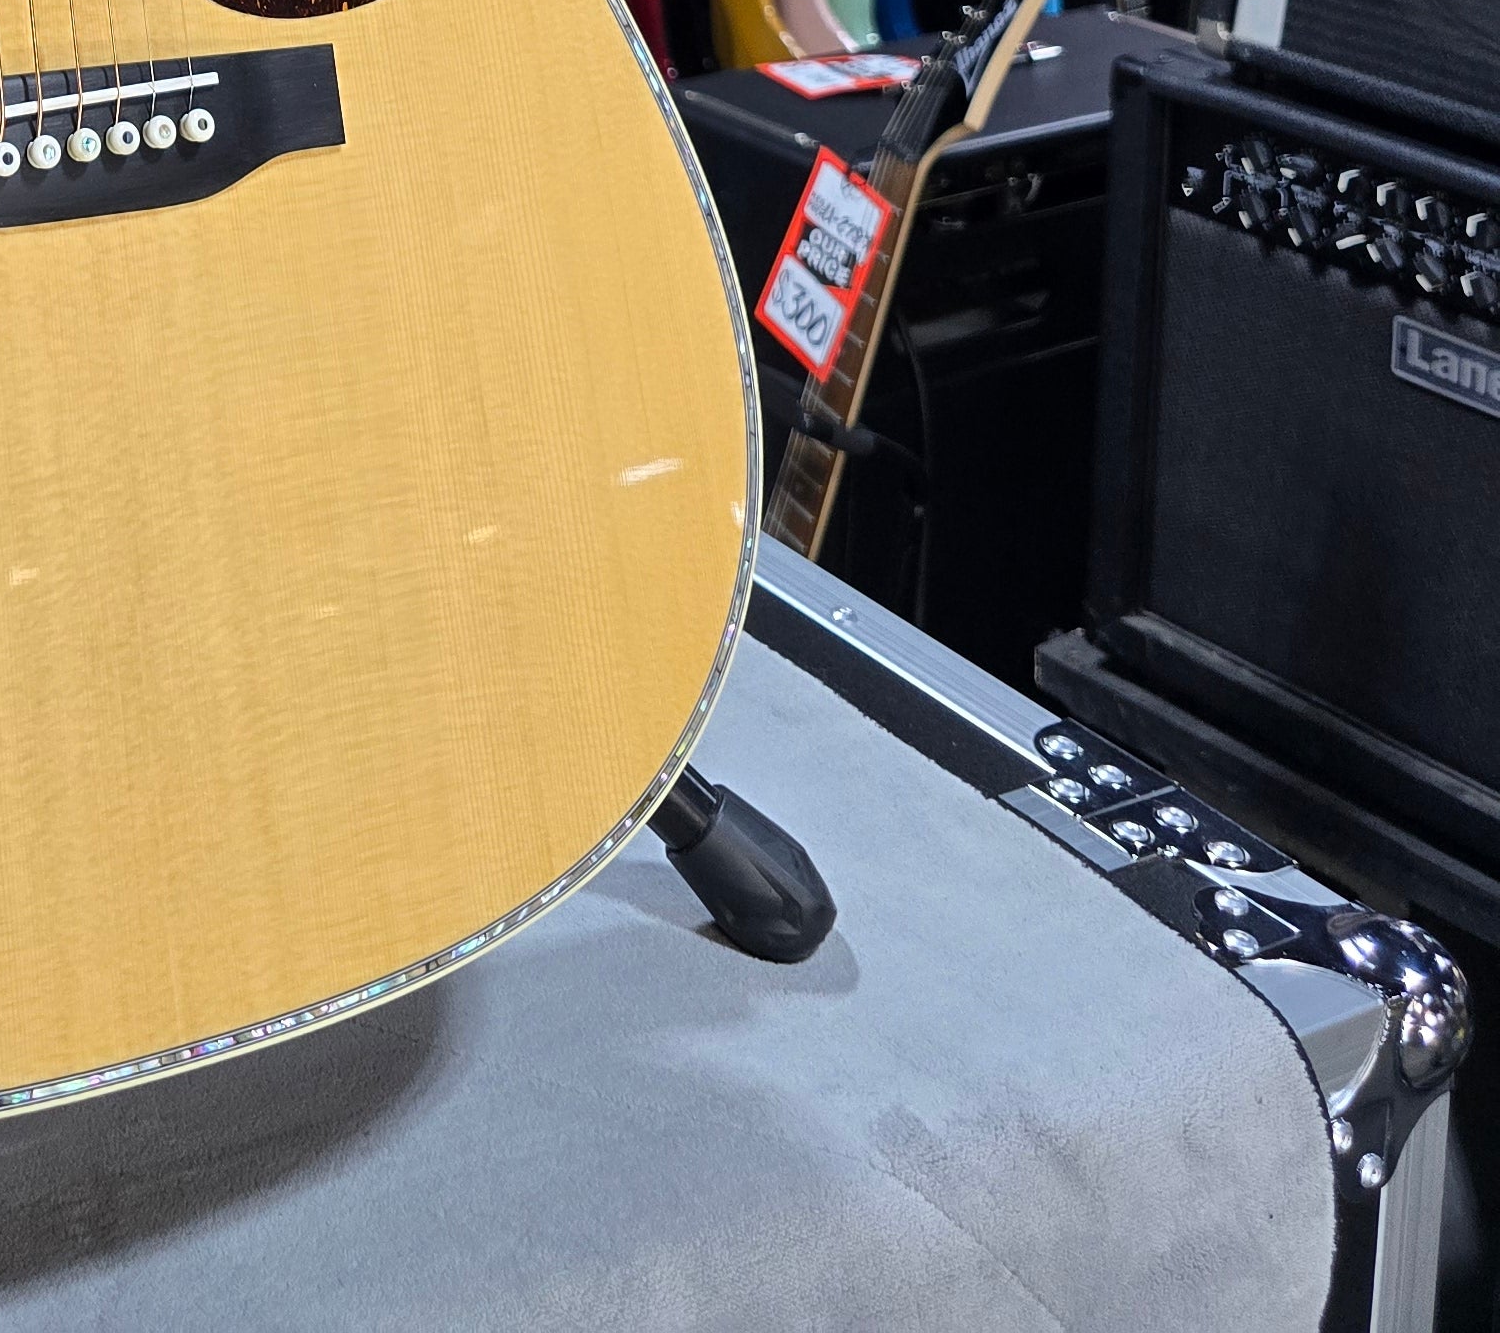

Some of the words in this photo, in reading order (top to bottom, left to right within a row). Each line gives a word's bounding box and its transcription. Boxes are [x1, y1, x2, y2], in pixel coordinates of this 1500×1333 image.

[796, 238, 852, 288] PRICE
[807, 227, 851, 266] OUR
[771, 268, 829, 346] $300
